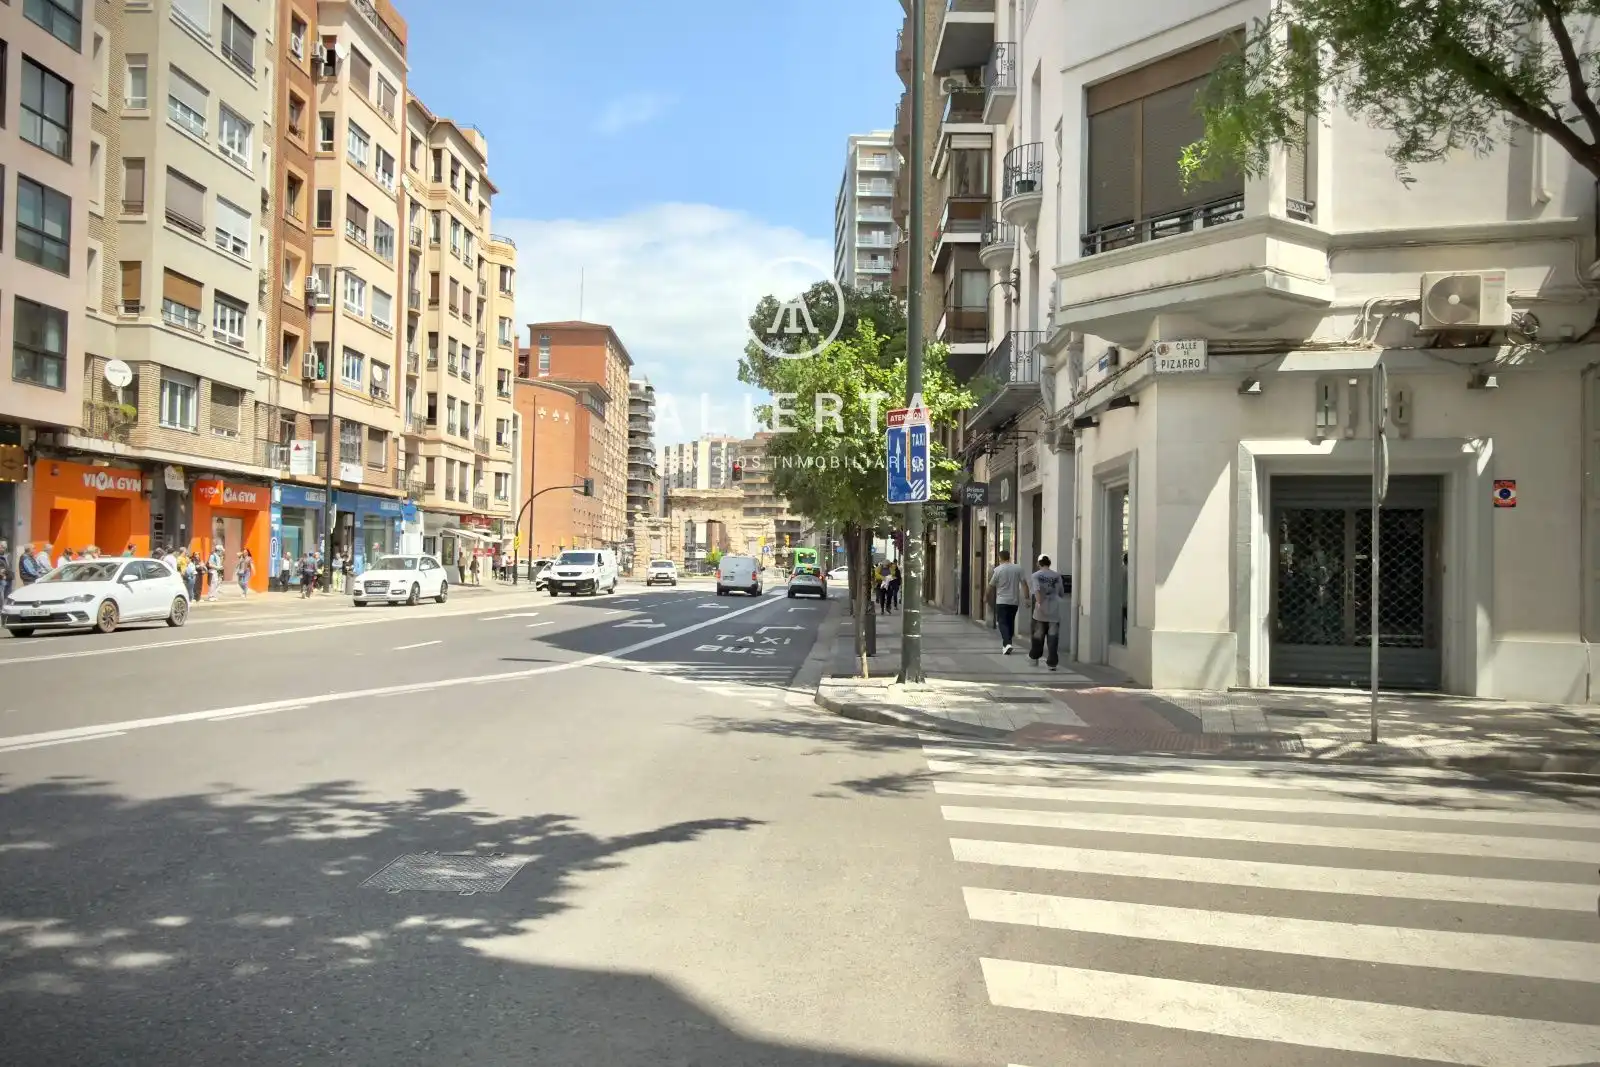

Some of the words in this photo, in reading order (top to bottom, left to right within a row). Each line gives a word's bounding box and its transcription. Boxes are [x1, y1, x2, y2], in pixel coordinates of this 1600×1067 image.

[1175, 342, 1198, 350] CALLE
[1161, 358, 1201, 369] PIZARRO
[911, 433, 926, 447] TAXI
[117, 477, 142, 492] GYM
[239, 491, 257, 503] GYM
[715, 634, 792, 645] TAXI
[693, 644, 778, 655] BUS
